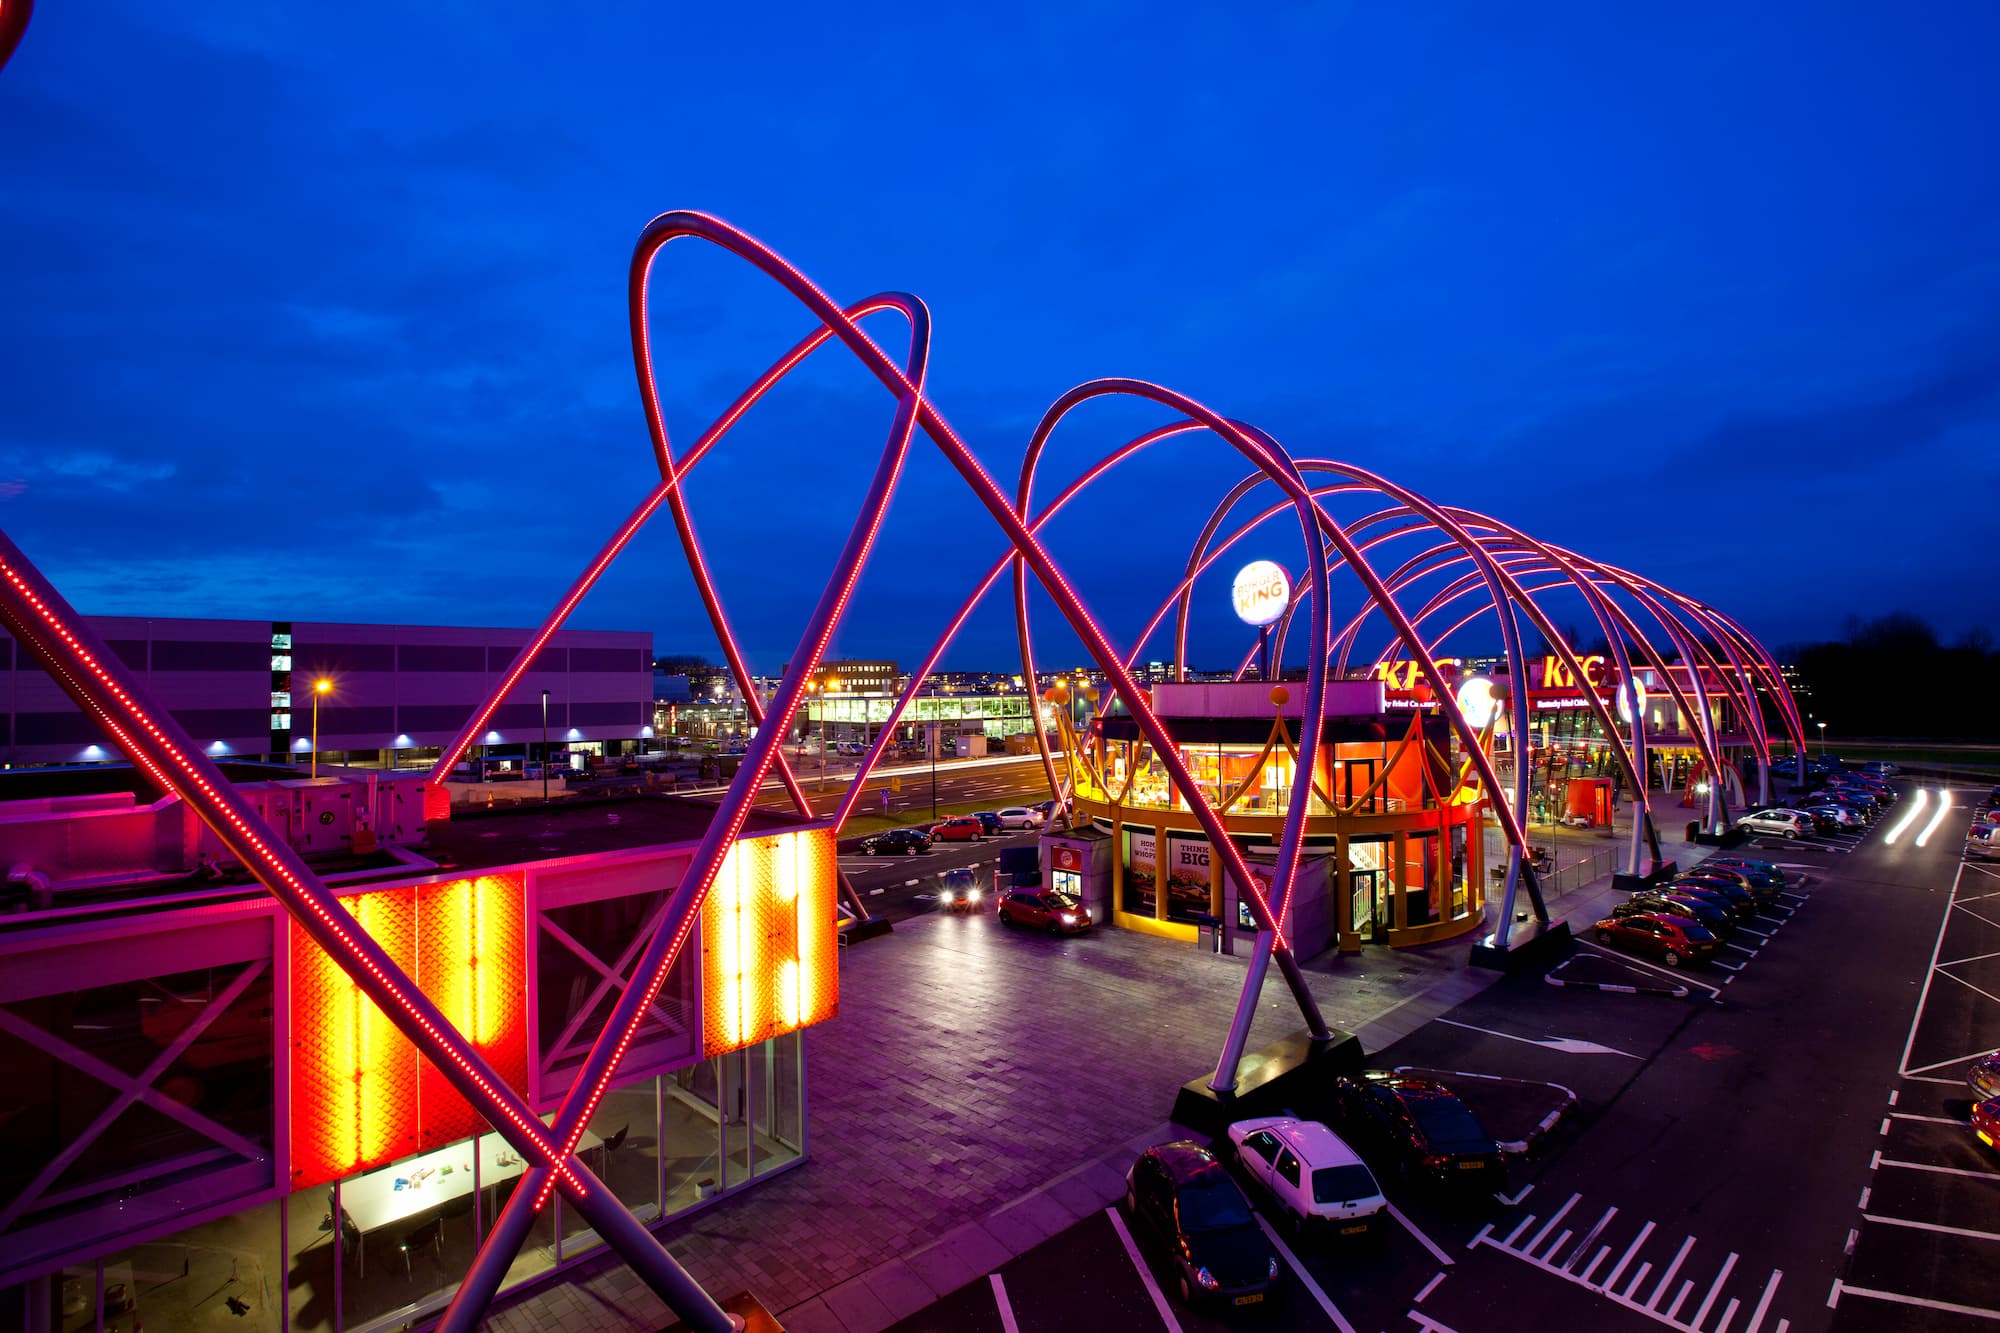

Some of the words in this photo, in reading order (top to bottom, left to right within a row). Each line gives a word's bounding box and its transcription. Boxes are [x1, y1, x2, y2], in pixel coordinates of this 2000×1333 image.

[1240, 581, 1283, 614] KING
[1543, 655, 1599, 688] KFC
[1140, 840, 1156, 848] HOM
[1180, 844, 1209, 854] THINK
[1134, 850, 1156, 860] WHOP
[1180, 852, 1210, 867] BIG
